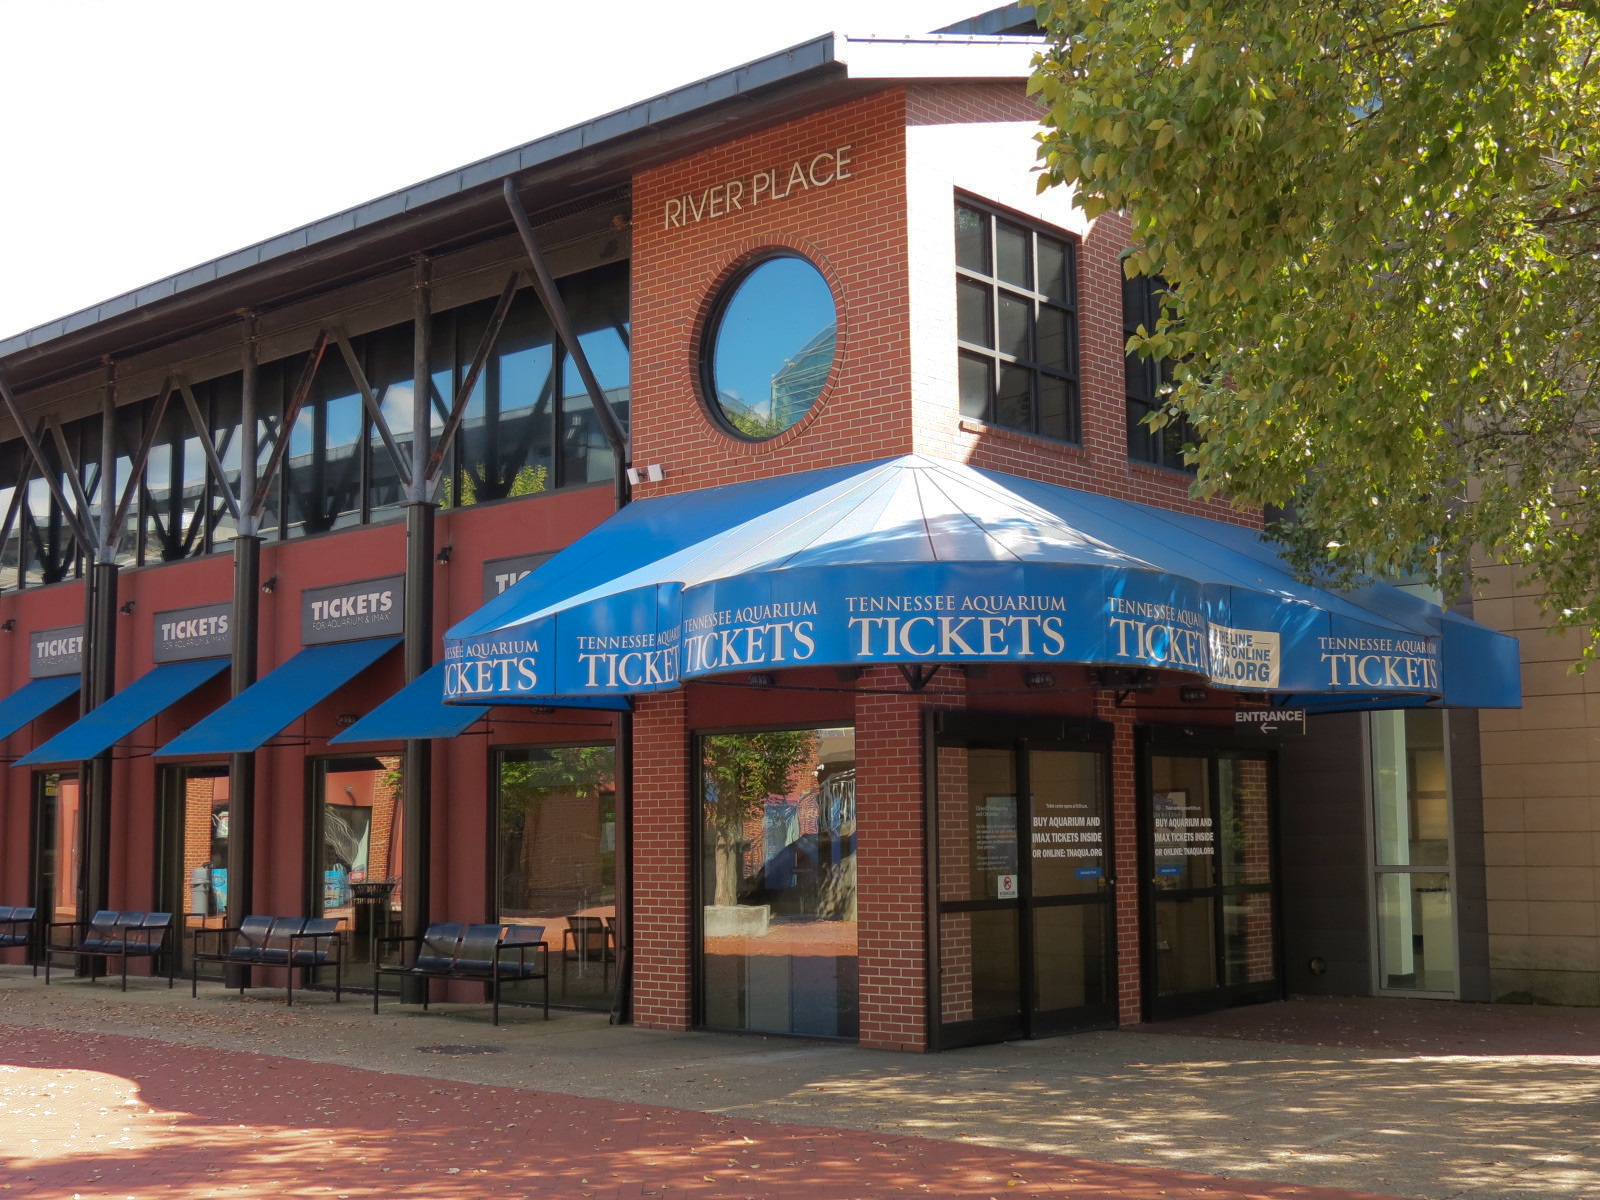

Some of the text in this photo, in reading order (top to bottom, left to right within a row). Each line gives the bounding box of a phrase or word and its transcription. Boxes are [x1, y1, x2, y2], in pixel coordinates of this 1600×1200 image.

[664, 145, 852, 231] RIVER PLACE
[312, 590, 393, 621] TICKETS
[846, 595, 1067, 614] TENNESSEE AQUARIUM
[1108, 597, 1176, 622] TENNESSEE
[313, 622, 326, 631] FOR
[327, 616, 363, 629] AQUARIUM
[684, 600, 818, 634] TENNESSEE AQUARIUM
[162, 614, 229, 641] TICKETS
[848, 614, 1066, 656] TICKETS
[577, 633, 655, 650] TENNESSEE
[684, 620, 815, 674] TICKETS
[1231, 632, 1253, 647] LINE
[1318, 636, 1437, 656] TENNESSEE AQUARIUM
[465, 639, 540, 659] AQUARIUM
[1231, 646, 1271, 662] ONLINE
[1321, 652, 1438, 689] TICKETS
[1235, 710, 1303, 722] ENTRANCE
[1033, 816, 1101, 828] BUY AQUARIUM AND
[1155, 818, 1213, 829] BUY AQUARIUM AND
[1032, 832, 1102, 843] IMAX TICKETS INSIDE
[1154, 832, 1214, 842] IMAX TICKETS INSIDE
[1032, 848, 1103, 858] OR ONLINE: TNAQUA.ORG
[1154, 848, 1163, 856] OR
